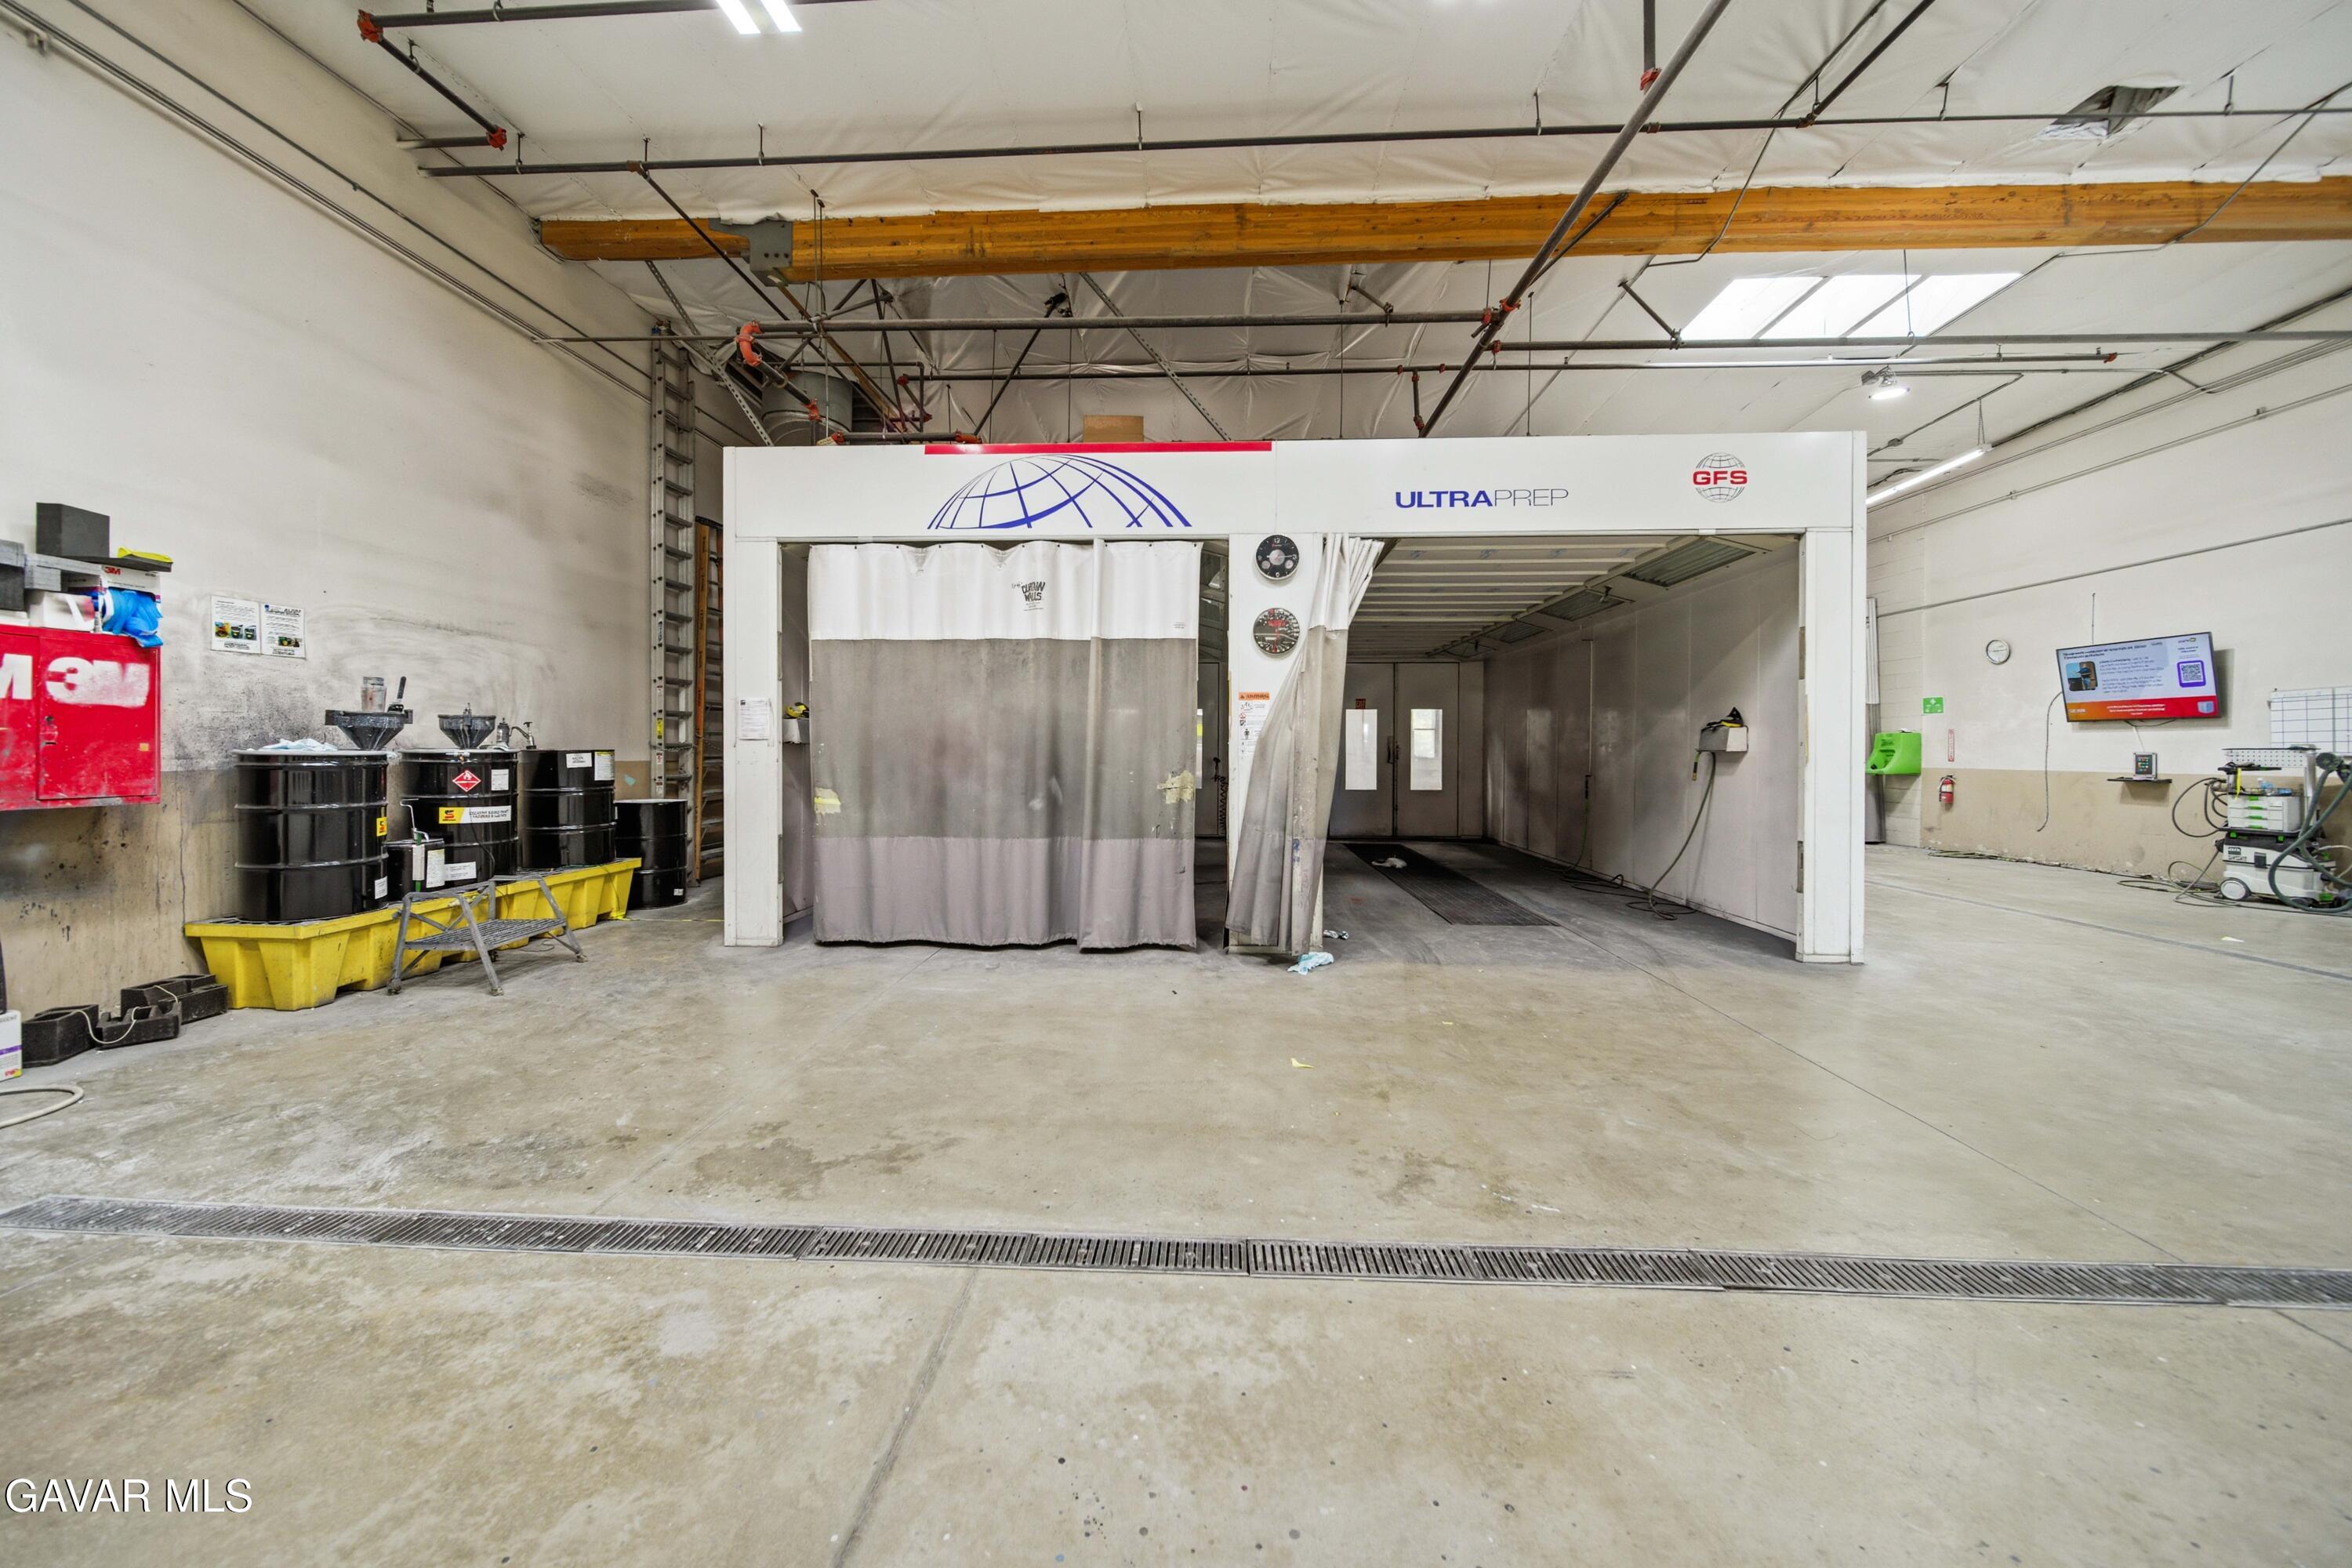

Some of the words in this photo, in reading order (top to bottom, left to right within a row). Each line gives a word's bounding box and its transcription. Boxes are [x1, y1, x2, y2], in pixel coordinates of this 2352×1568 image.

[1693, 470, 1748, 485] GFS
[1396, 488, 1569, 509] ULTRAPREP
[104, 566, 121, 575] 3M
[45, 656, 151, 709] 3M
